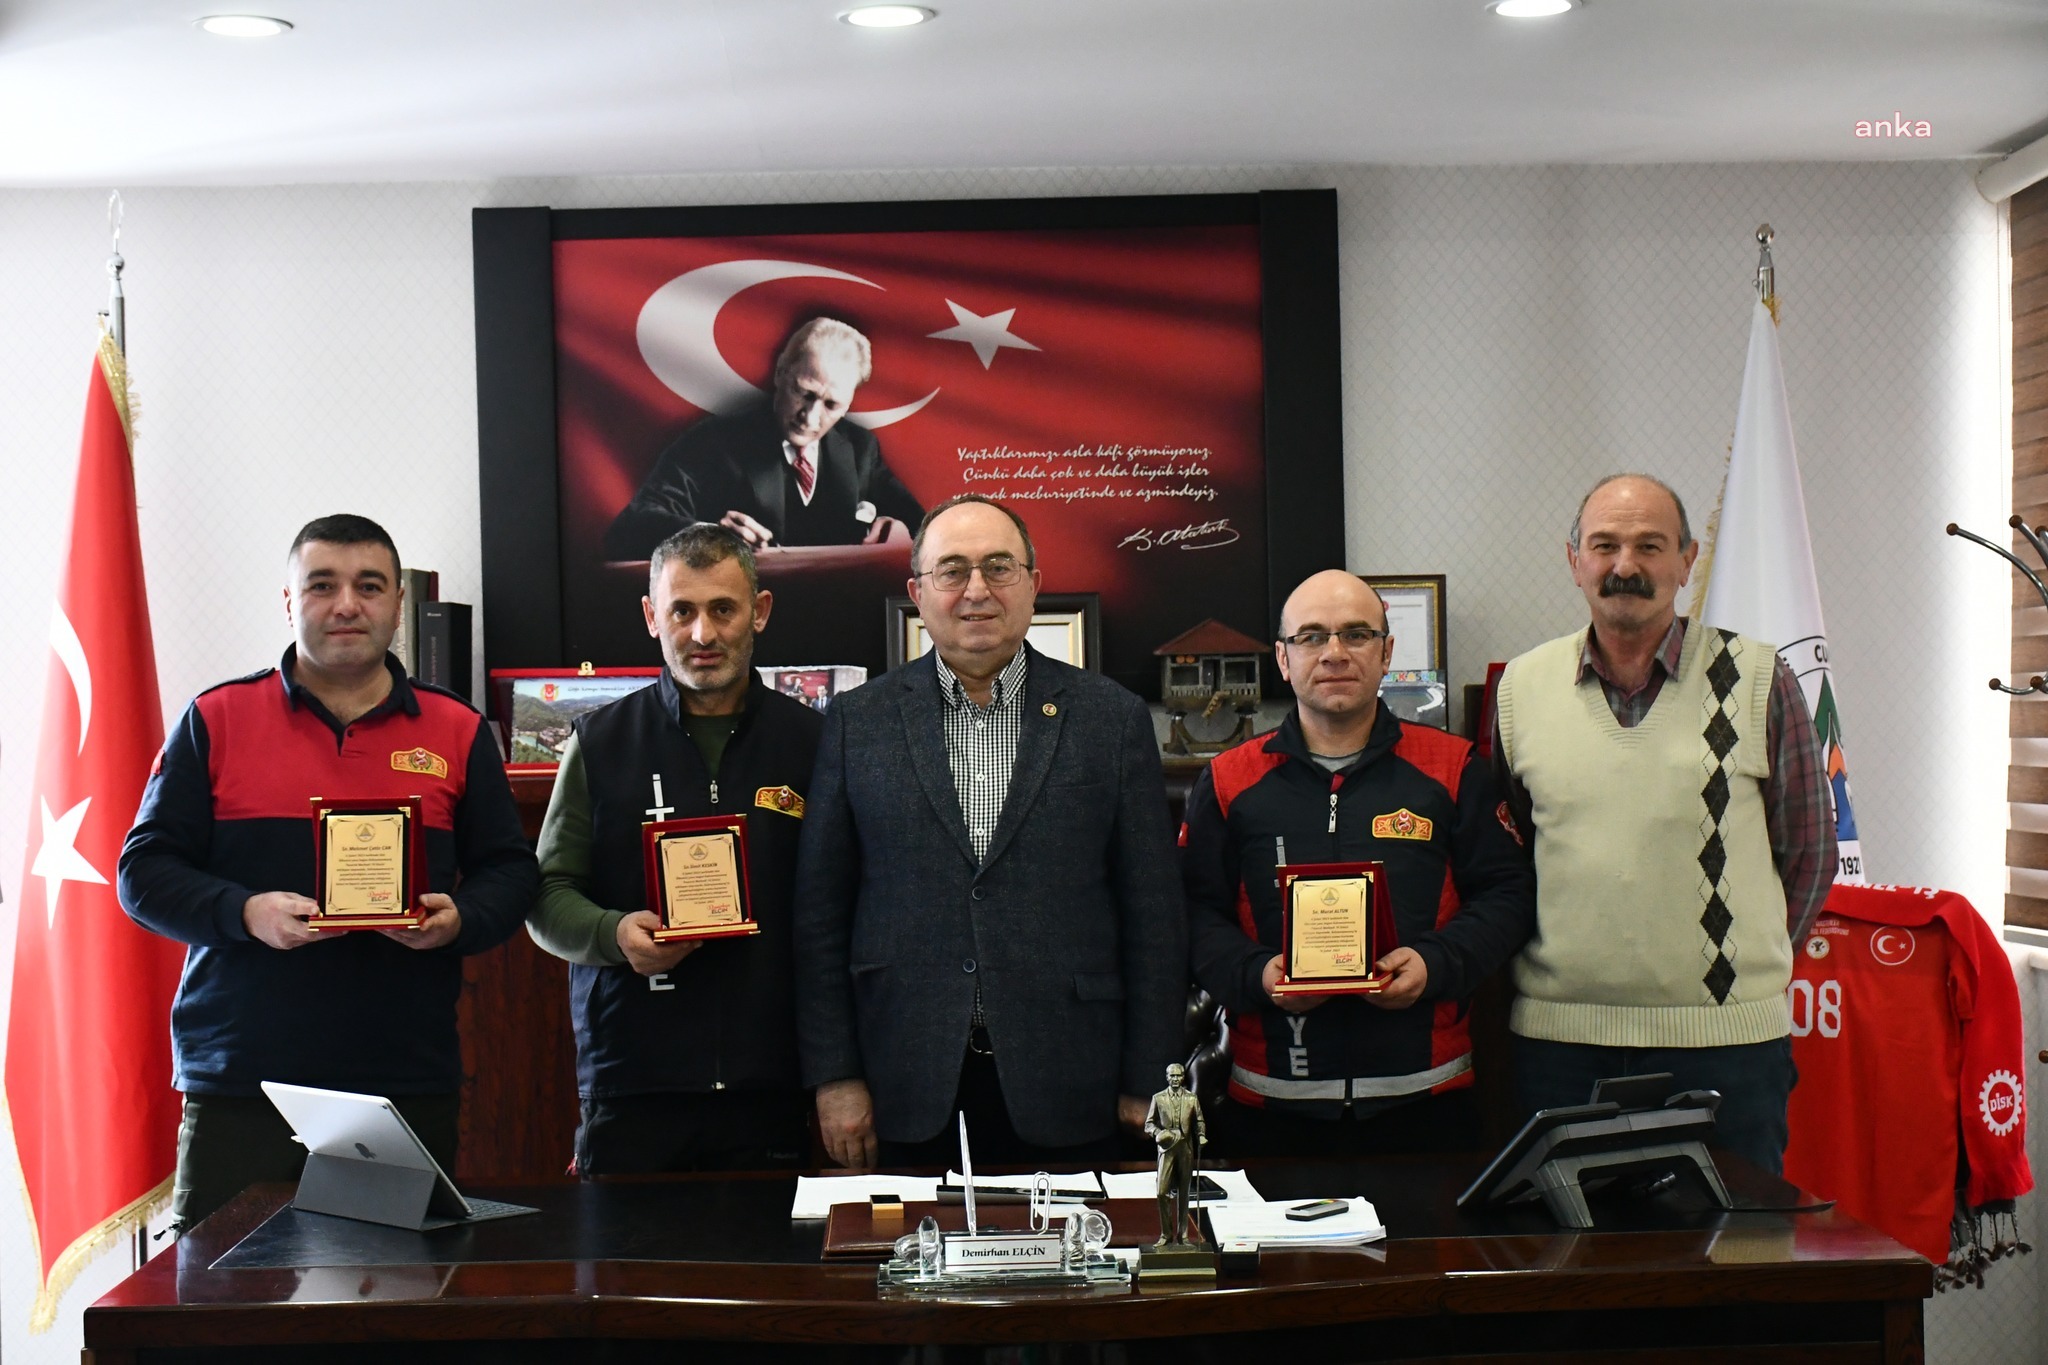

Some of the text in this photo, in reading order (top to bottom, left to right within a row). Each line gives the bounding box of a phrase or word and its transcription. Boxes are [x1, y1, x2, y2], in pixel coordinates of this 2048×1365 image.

[957, 446, 1060, 463] Yaptıklarımızı
[1062, 444, 1092, 458] asla
[1127, 444, 1212, 461] görmüyoruz.
[963, 462, 1209, 483] Çünkü daha çok ve daha büyük işler
[1011, 485, 1115, 504] mecburiyetinde
[1118, 487, 1133, 497] ve
[1136, 483, 1219, 502] azmindeyiz.
[962, 1245, 1046, 1257] Demirhan ELÇİN
